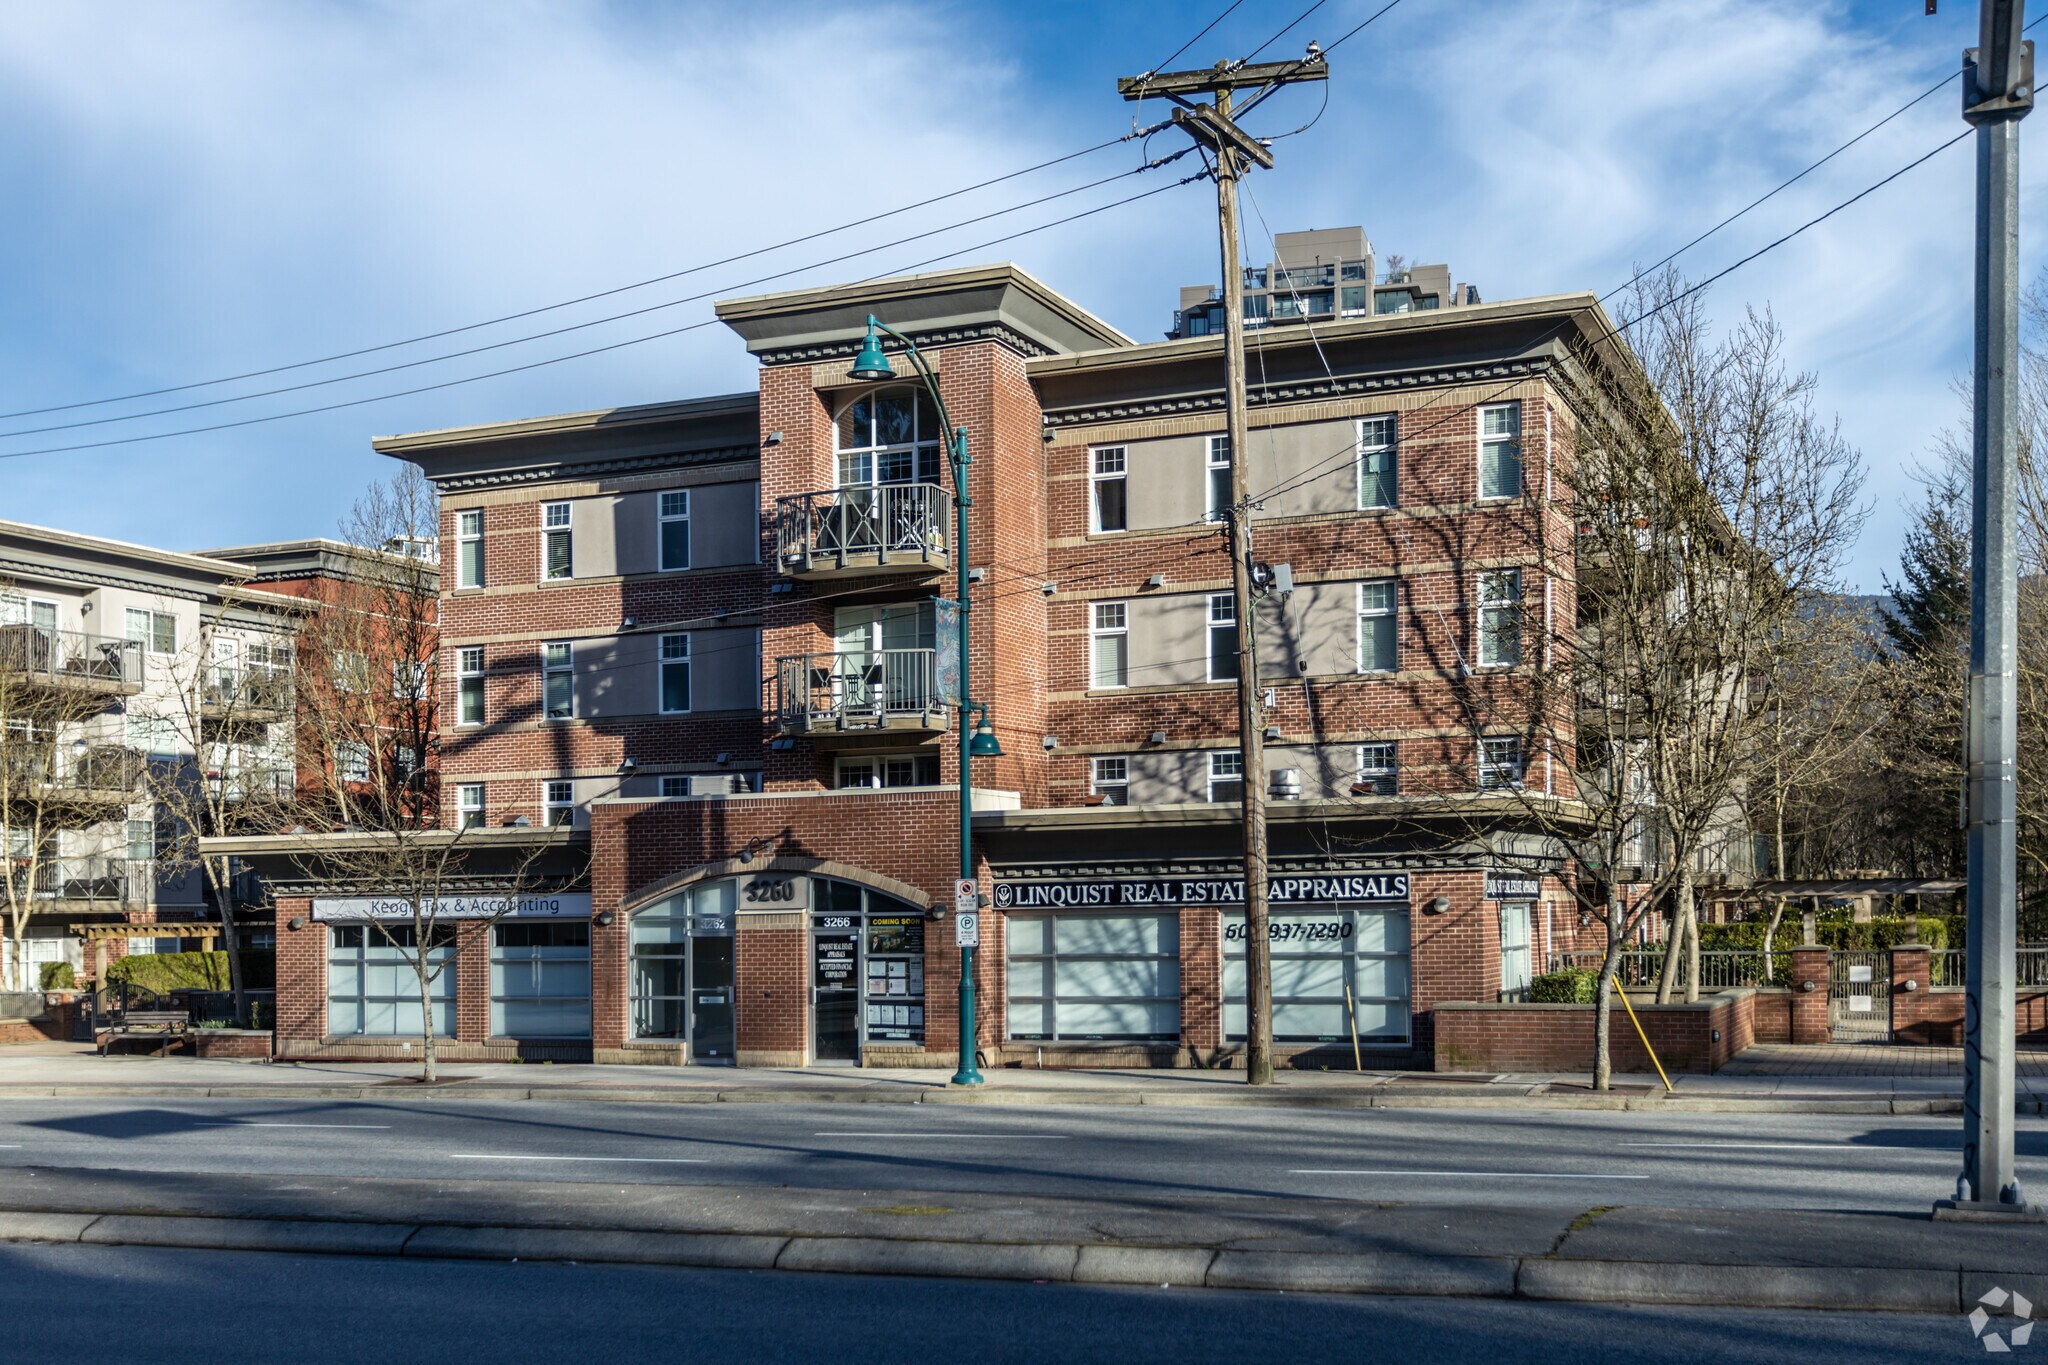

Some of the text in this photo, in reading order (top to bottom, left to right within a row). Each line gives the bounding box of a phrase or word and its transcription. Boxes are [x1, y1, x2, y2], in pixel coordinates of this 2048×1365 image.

[742, 880, 795, 902] 3260
[1015, 876, 1407, 907] LINQUIST REAL ESTAT APPRAISALS
[371, 899, 415, 917] Keog
[454, 898, 465, 912] &
[701, 919, 726, 929] 3262
[823, 917, 851, 928] 3266
